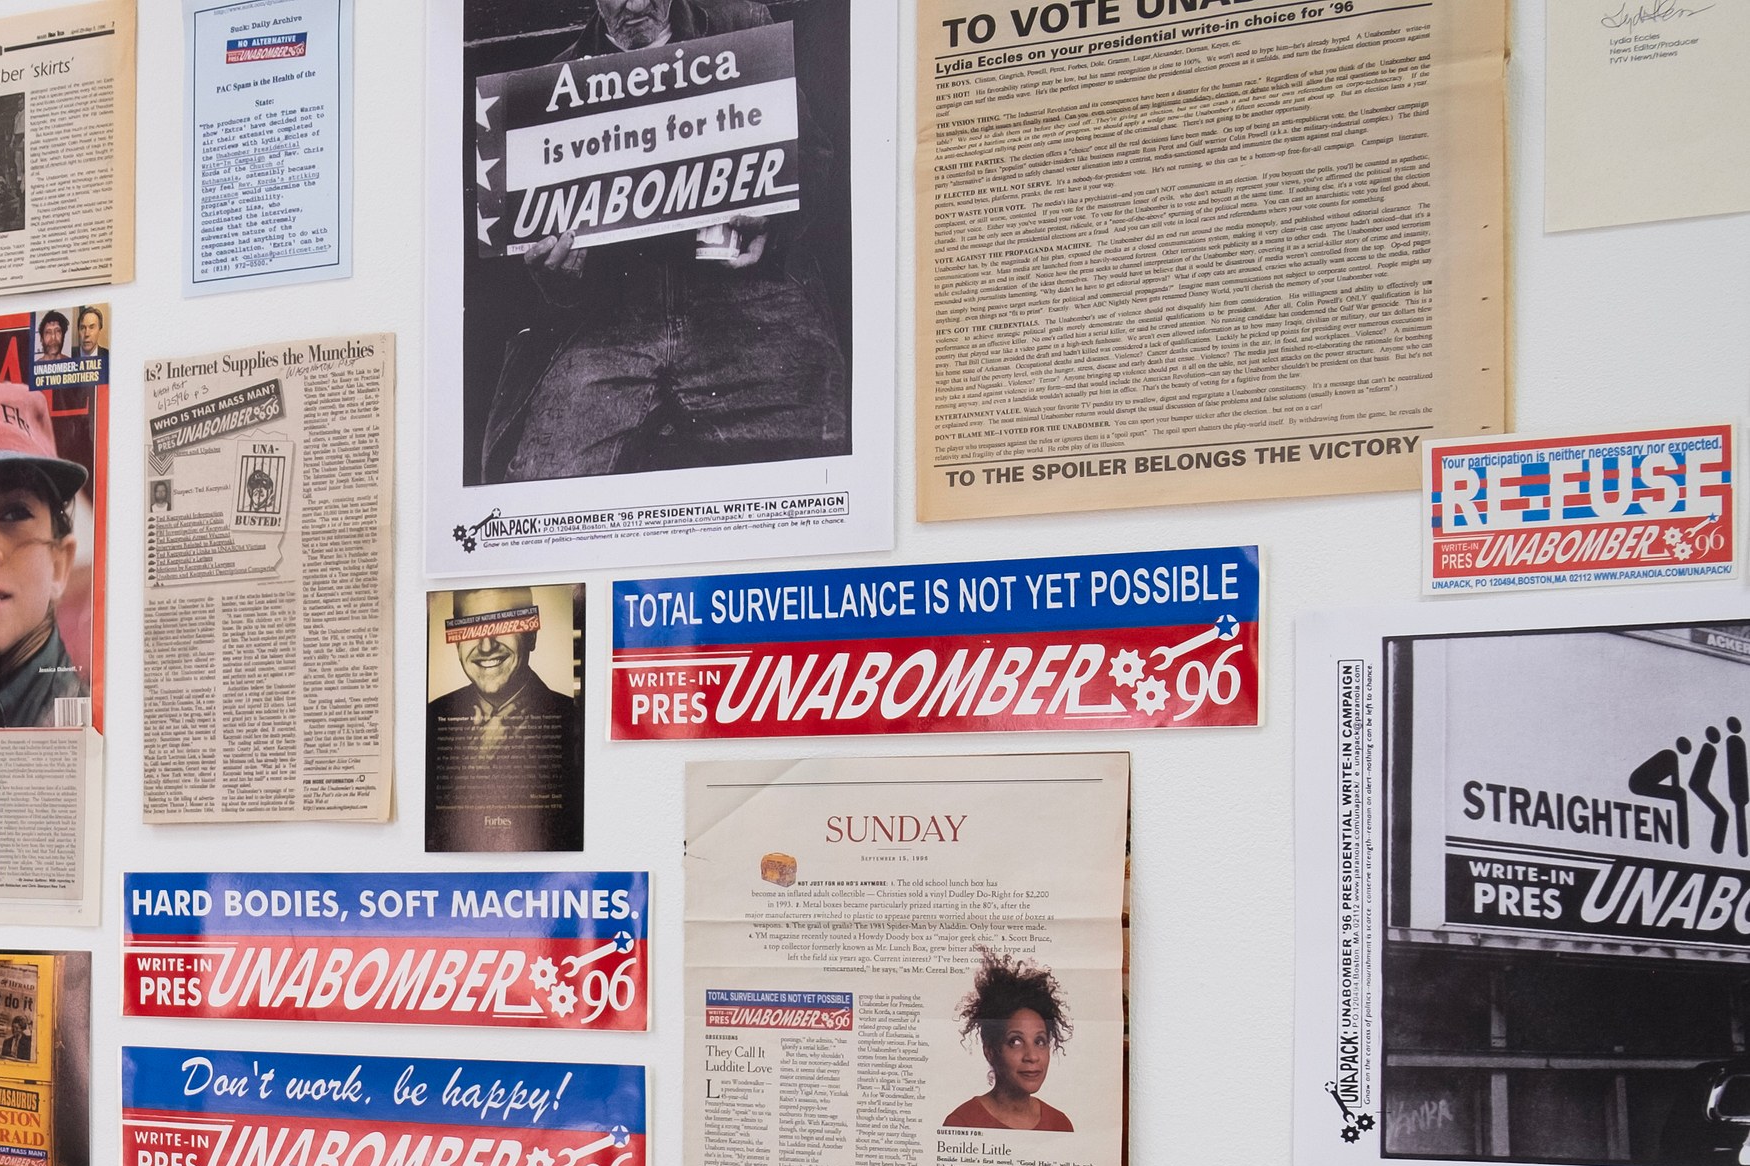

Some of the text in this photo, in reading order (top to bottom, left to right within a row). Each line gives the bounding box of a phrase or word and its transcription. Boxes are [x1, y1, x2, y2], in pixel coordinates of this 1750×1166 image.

[936, 59, 973, 76] Lydia
[977, 52, 1023, 69] Eccles
[1028, 49, 1046, 60] on
[1050, 44, 1084, 61] your
[1088, 28, 1177, 55] presidential
[1181, 18, 1239, 40] write-in
[1244, 12, 1297, 31] choice
[1301, 7, 1323, 22] for
[1329, 2, 1354, 16] '96
[942, 18, 996, 48] TO
[1012, 0, 1121, 37] VOTE
[1610, 34, 1660, 46] Lydia Eccles
[545, 49, 741, 113] America
[544, 103, 762, 165] is voting for the
[513, 148, 799, 238] UNABOMBER
[33, 358, 102, 376] UNABOMBER: A TALE
[35, 371, 99, 387] OF TWO BROTHERS
[166, 340, 375, 380] Internet Supplies the Munchies
[945, 435, 1420, 489] TO THE SPOILER BELONGS THE VICTORY
[1442, 437, 1722, 470] Your participation is neither necessary nor expected.
[484, 496, 844, 538] UNAPACK: UNABOMBER '96 PRESIDENTIAL WRITE-IN CAMPAIGN
[1475, 525, 1672, 568] UNABOMBER
[625, 562, 1240, 628] TOTAL SURVEILLANCE IS NOT YET POSSIBLE
[628, 669, 721, 689] WRITE-IN
[631, 691, 709, 725] PRES
[714, 643, 1127, 724] UNABOMBER
[826, 815, 967, 843] SUNDAY
[1463, 779, 1673, 845] STRAIGHTEN
[1469, 860, 1575, 886] WRITE-IN
[131, 888, 640, 923] HARD BODIES, SOFT MACHINES.
[1474, 882, 1563, 920] PRES
[139, 976, 202, 1007] PRES
[208, 947, 544, 1014] UNABOMBER
[705, 1045, 765, 1059] They Call It
[705, 1060, 772, 1074] Luddite Love
[181, 1056, 275, 1099] Don't
[393, 1064, 428, 1102] be
[442, 1071, 574, 1123] happy!
